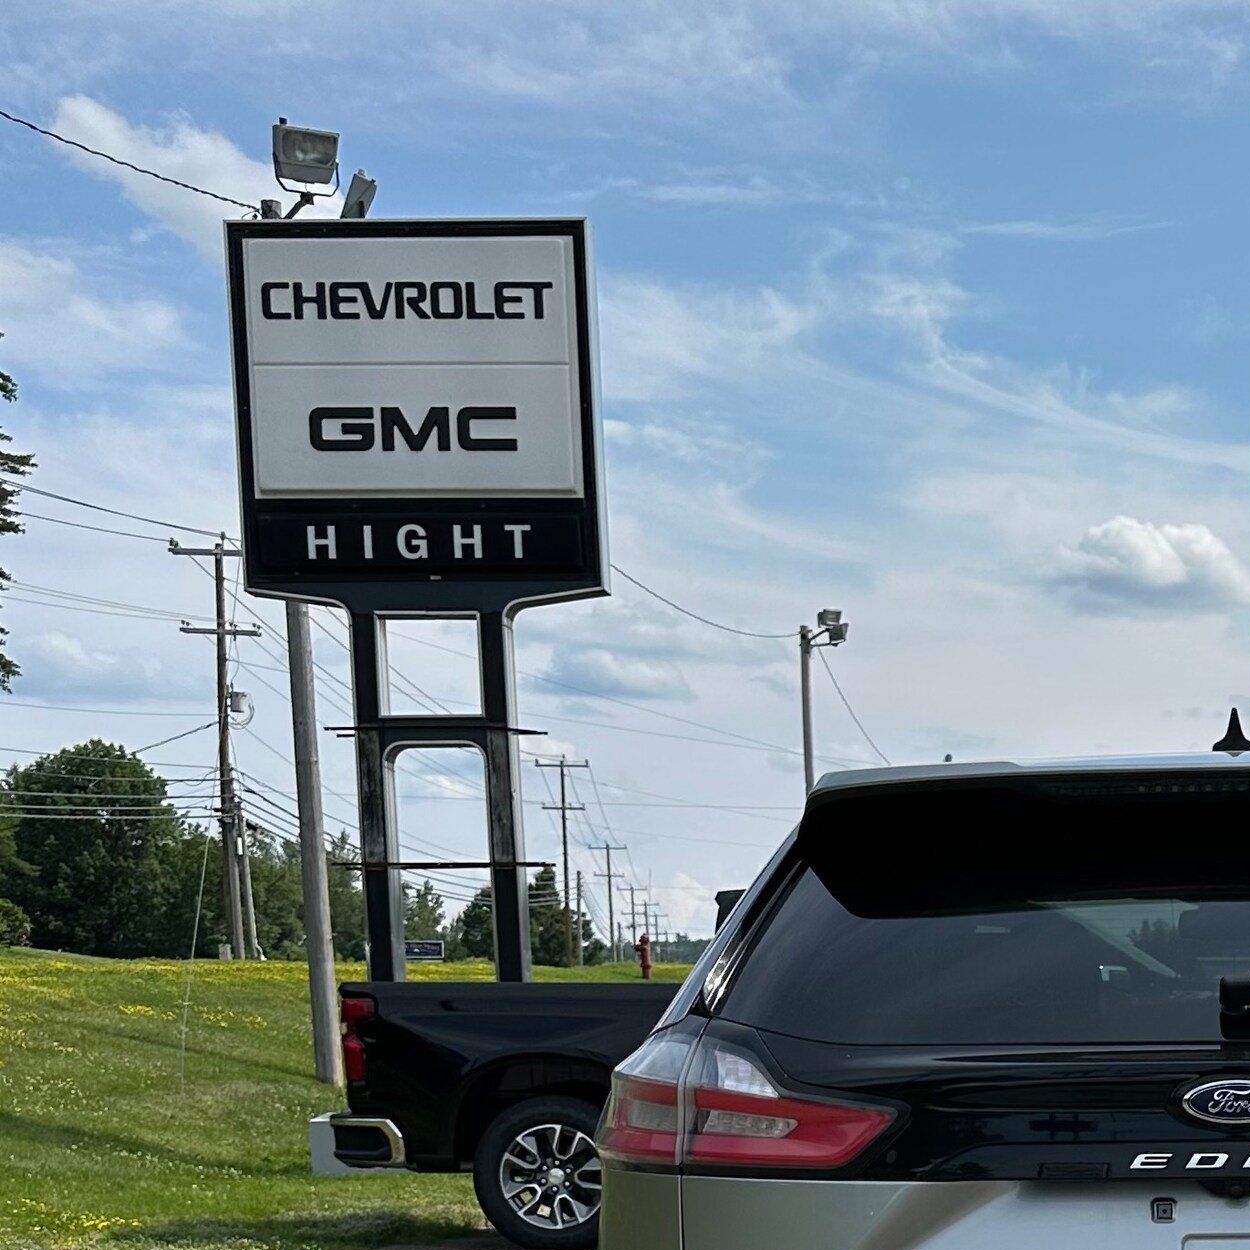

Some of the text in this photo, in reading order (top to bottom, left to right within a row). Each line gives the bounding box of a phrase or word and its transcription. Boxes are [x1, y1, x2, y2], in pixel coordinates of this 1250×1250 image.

[260, 281, 553, 320] CHEVROLET
[308, 406, 518, 452] GMC
[306, 523, 532, 560] HIGHT
